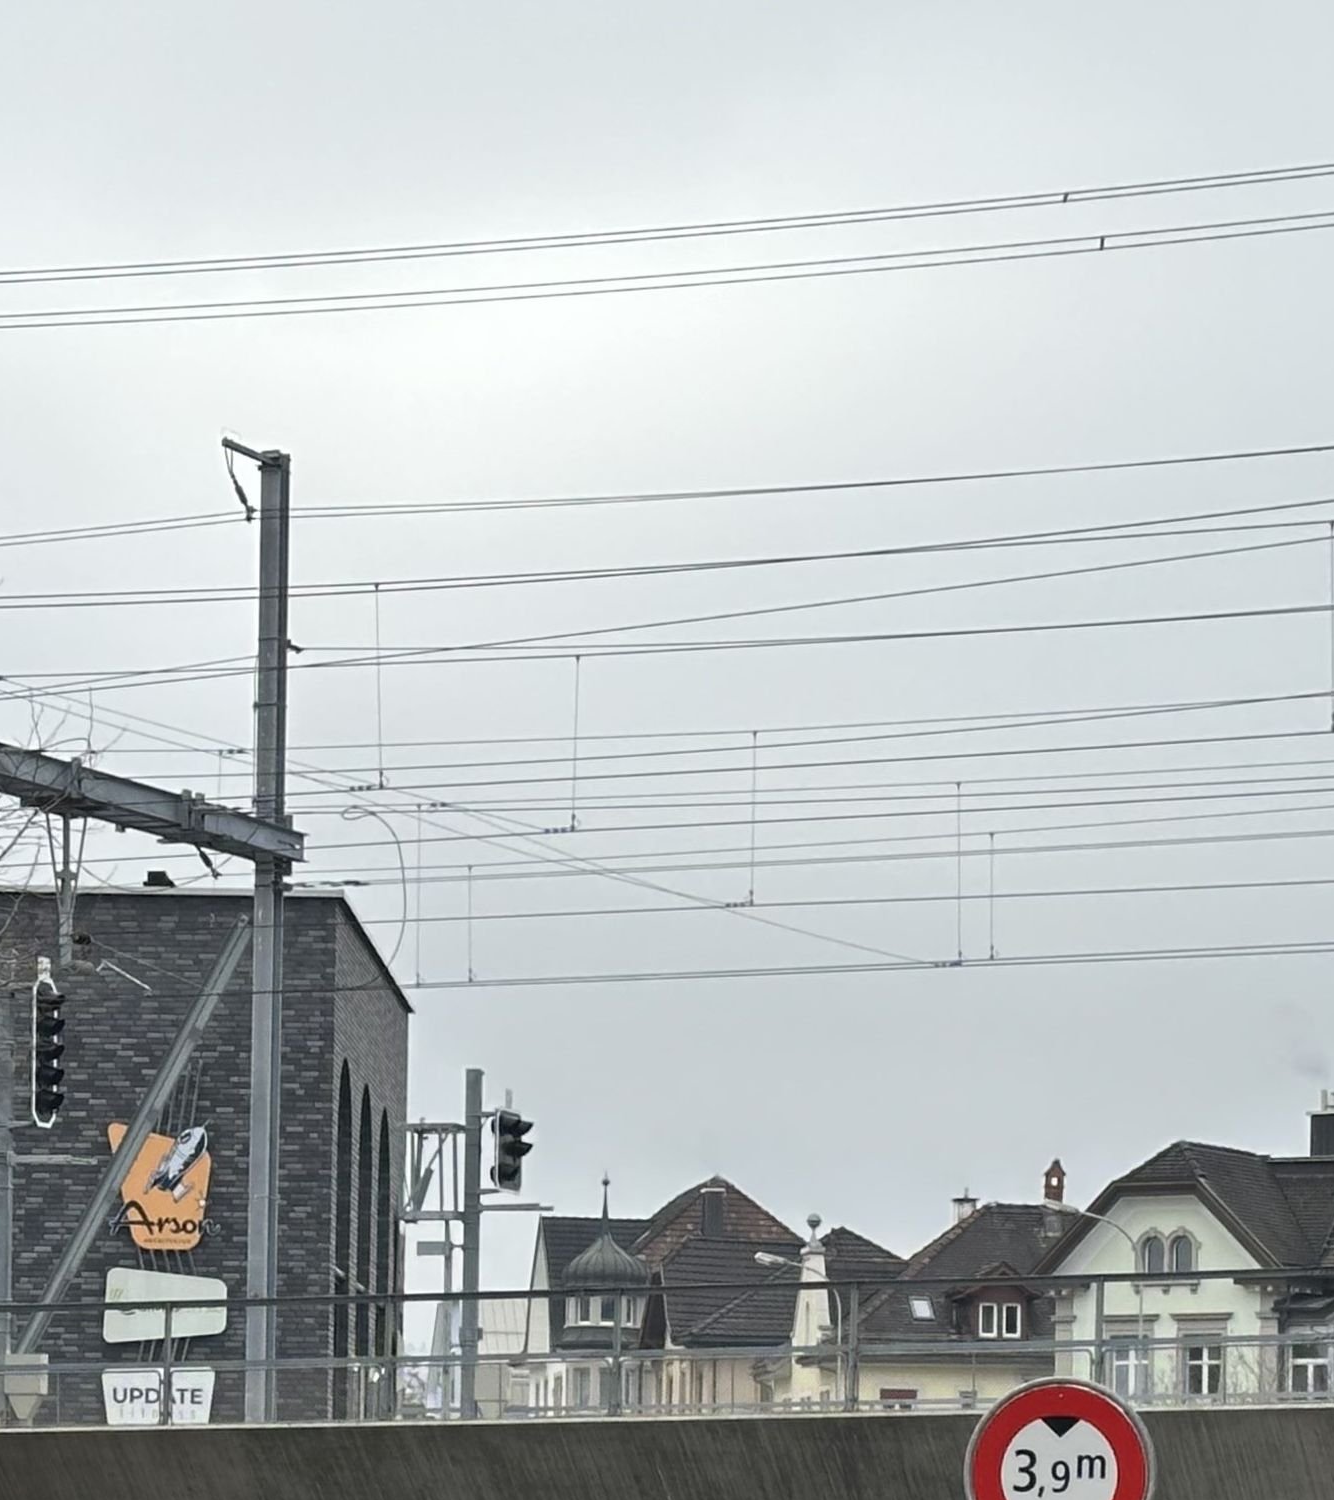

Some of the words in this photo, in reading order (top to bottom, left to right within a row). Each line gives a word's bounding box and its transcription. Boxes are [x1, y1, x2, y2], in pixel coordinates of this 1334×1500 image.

[108, 1200, 221, 1236] Arson
[113, 1387, 203, 1405] UPDTE
[1012, 1448, 1106, 1498] 3,9m
